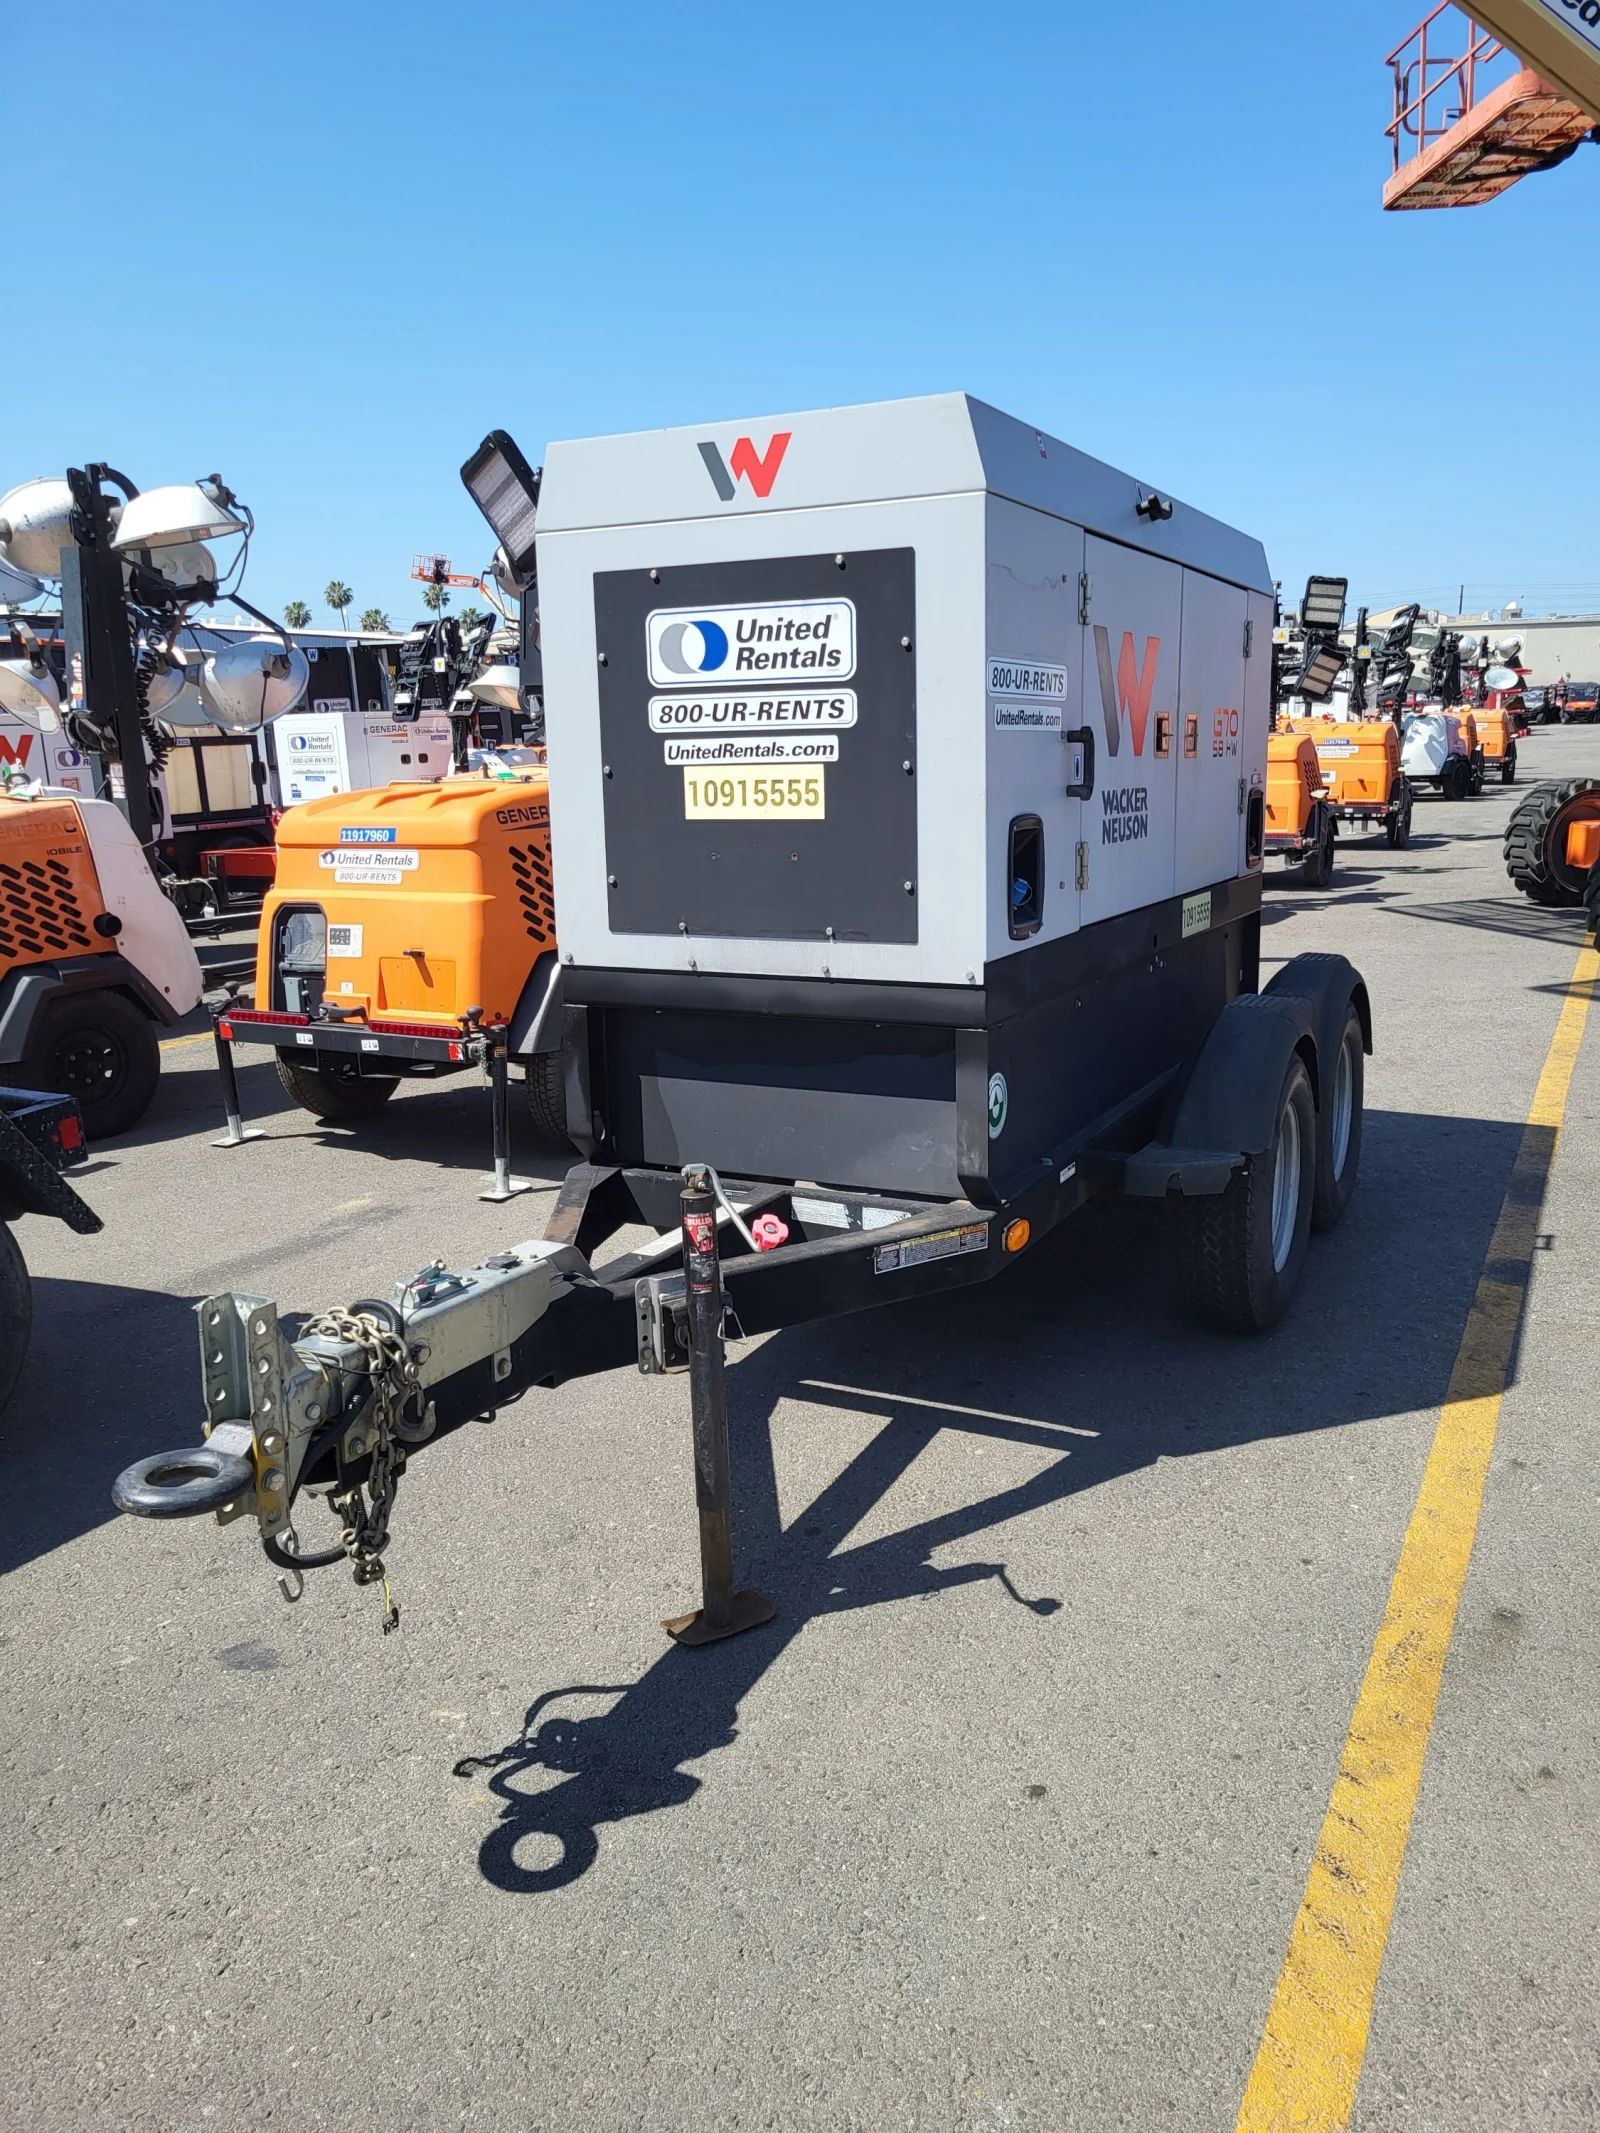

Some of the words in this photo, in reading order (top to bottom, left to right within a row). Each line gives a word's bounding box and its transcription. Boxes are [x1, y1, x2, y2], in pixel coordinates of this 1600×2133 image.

[736, 614, 832, 643] United
[735, 643, 842, 671] Rentals
[992, 667, 1064, 693] 800-UR-RENTS
[659, 698, 845, 724] 800-UR-RENTS
[995, 708, 1061, 727] UnitedRentals.com
[1213, 708, 1239, 737] G70
[370, 725, 408, 733] GENERAC
[667, 741, 835, 761] UnitedRentals.com
[688, 778, 820, 807] 10915555
[1101, 787, 1148, 816] WACKER
[341, 829, 390, 842] 11917960
[1102, 814, 1148, 845] NEUSON
[338, 854, 372, 865] United
[374, 854, 413, 866] Rentals
[340, 872, 397, 881] 800-UR-RENTS
[1183, 901, 1210, 929] 10915555
